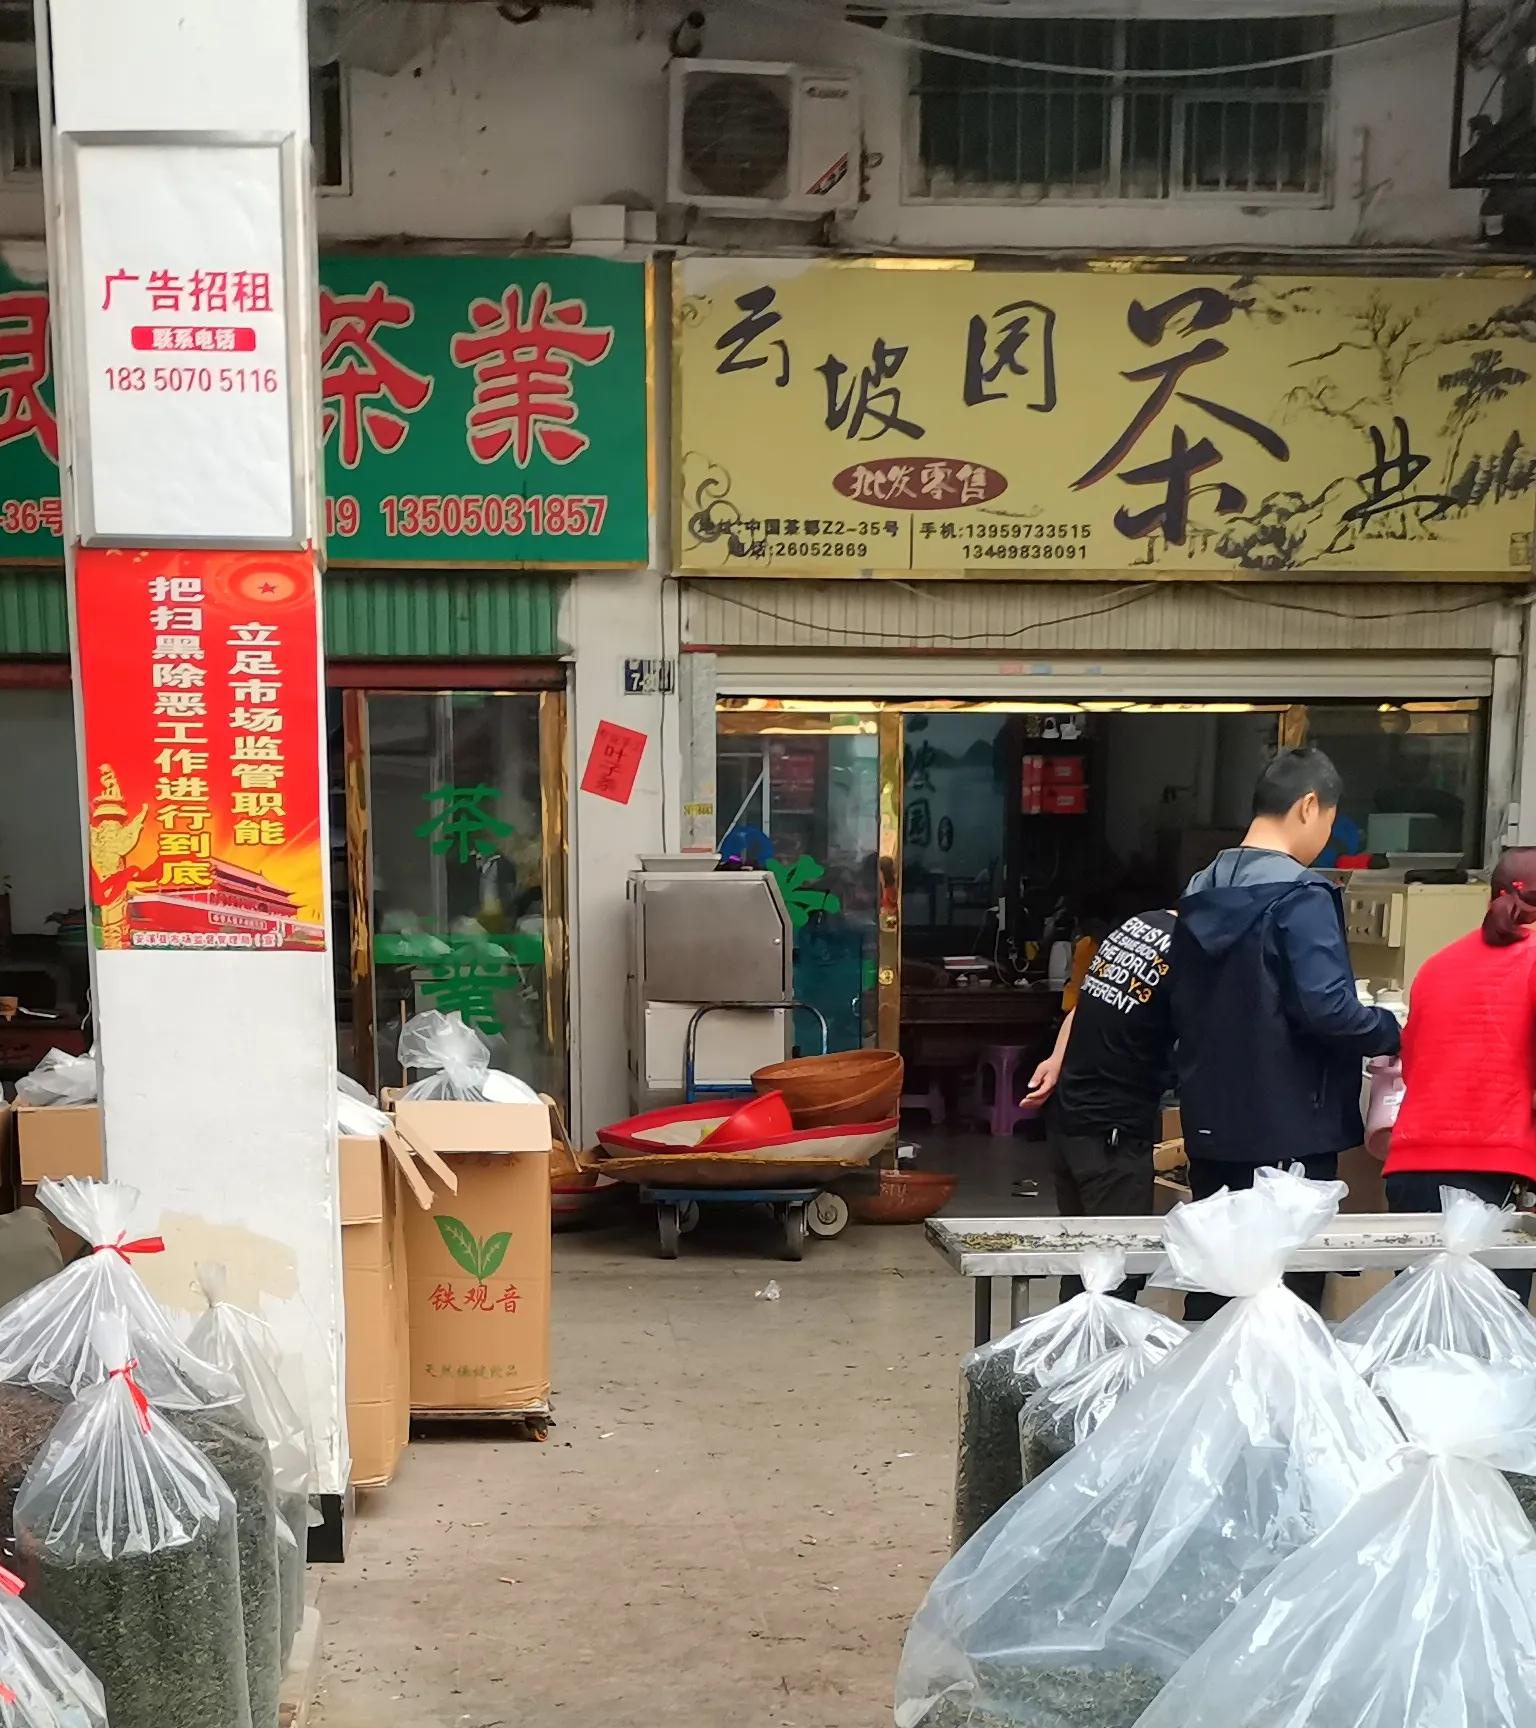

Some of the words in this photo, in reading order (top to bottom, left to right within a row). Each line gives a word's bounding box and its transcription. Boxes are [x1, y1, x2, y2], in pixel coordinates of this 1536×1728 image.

[101, 268, 275, 313] 广告招租
[151, 328, 236, 351] 联系电话
[104, 368, 146, 393] 183
[154, 367, 212, 393] 5070
[220, 367, 278, 394] 5116
[850, 460, 988, 504] 批发零售
[379, 495, 609, 536] 13505031857
[148, 576, 214, 887] 把扫黑除恶工作进行到底
[226, 621, 287, 846] 立足市场监管职能
[426, 1283, 522, 1314] 铁观音
